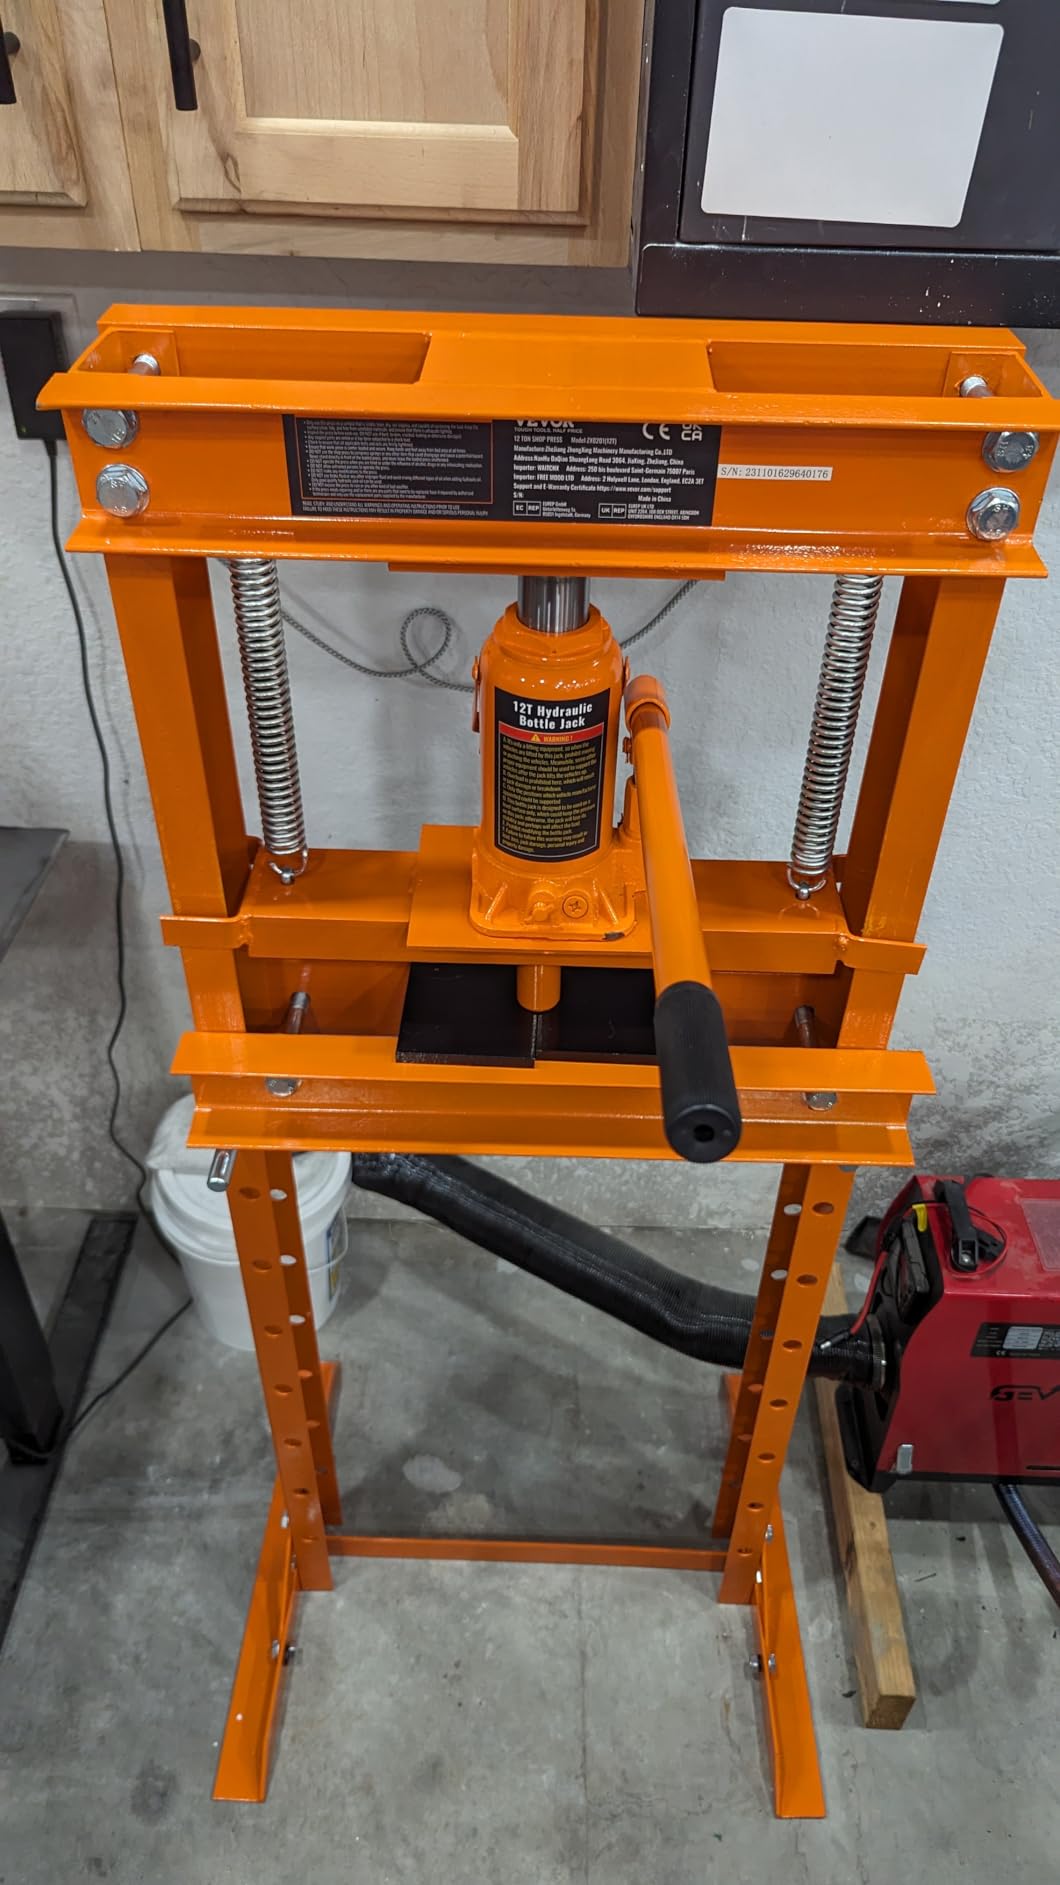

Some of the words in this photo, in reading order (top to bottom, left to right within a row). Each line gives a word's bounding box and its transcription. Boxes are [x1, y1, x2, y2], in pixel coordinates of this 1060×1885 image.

[720, 467, 742, 476] S/N:
[745, 468, 828, 479] 231101629640176
[513, 701, 533, 715] 12T
[537, 703, 593, 718] Hydraulic
[519, 715, 555, 729] Bottle
[560, 716, 585, 729] Jack
